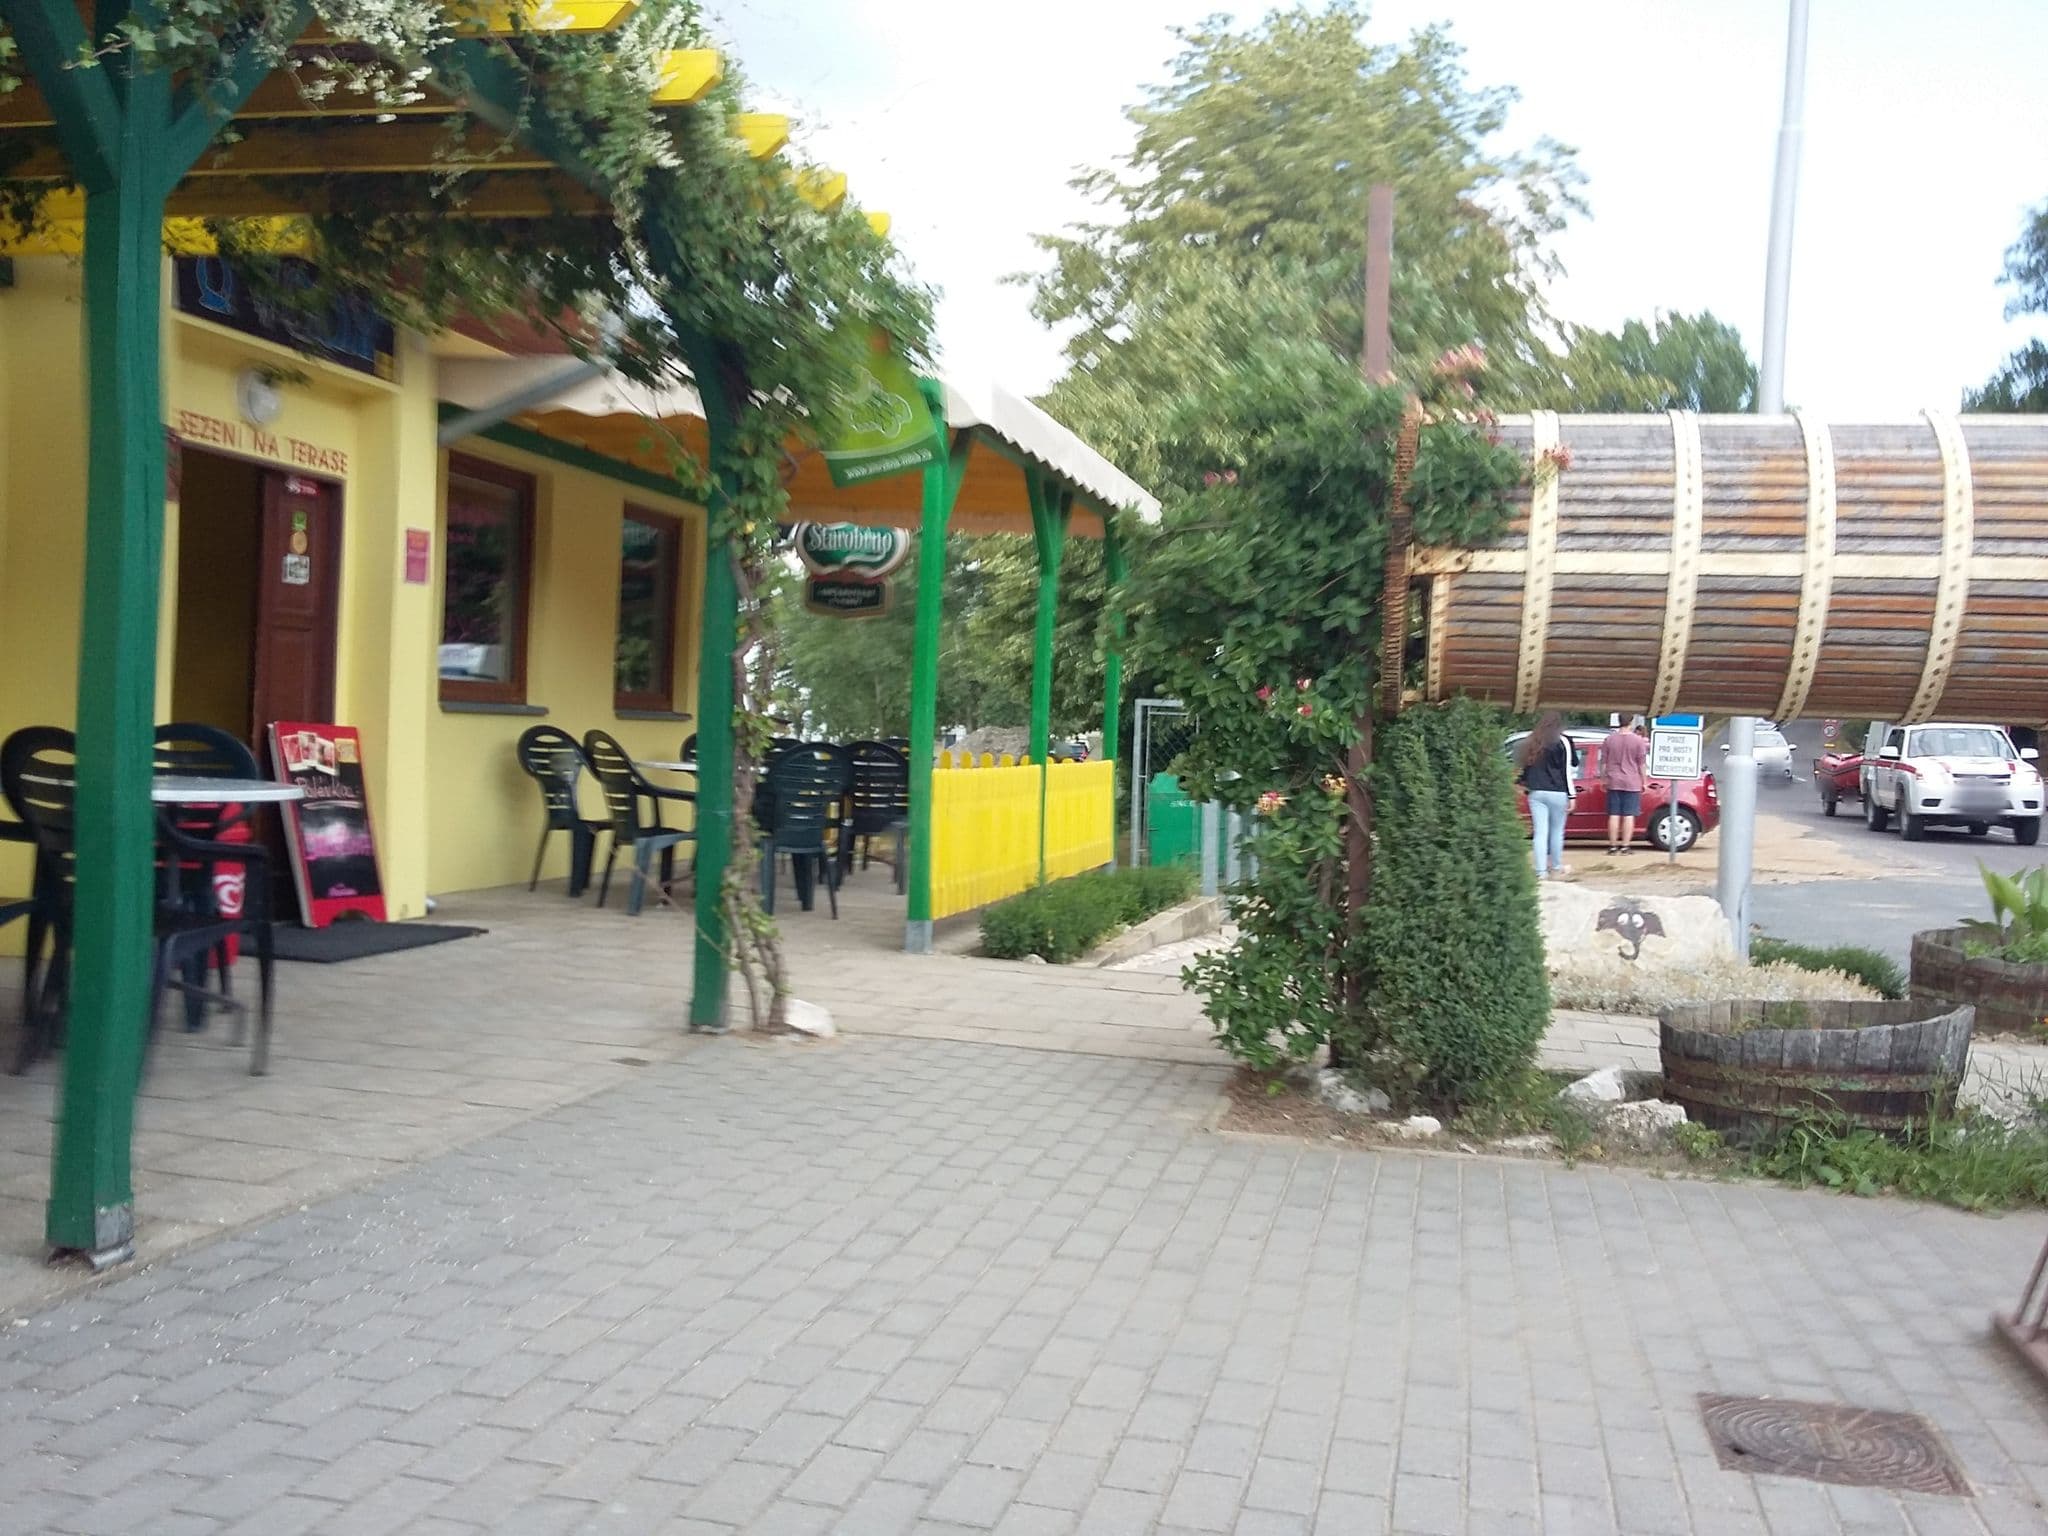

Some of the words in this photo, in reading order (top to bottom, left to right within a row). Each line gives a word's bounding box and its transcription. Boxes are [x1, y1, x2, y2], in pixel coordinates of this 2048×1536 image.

[253, 429, 281, 458] NA
[288, 437, 349, 474] TERASE
[808, 523, 892, 558] Starobrno
